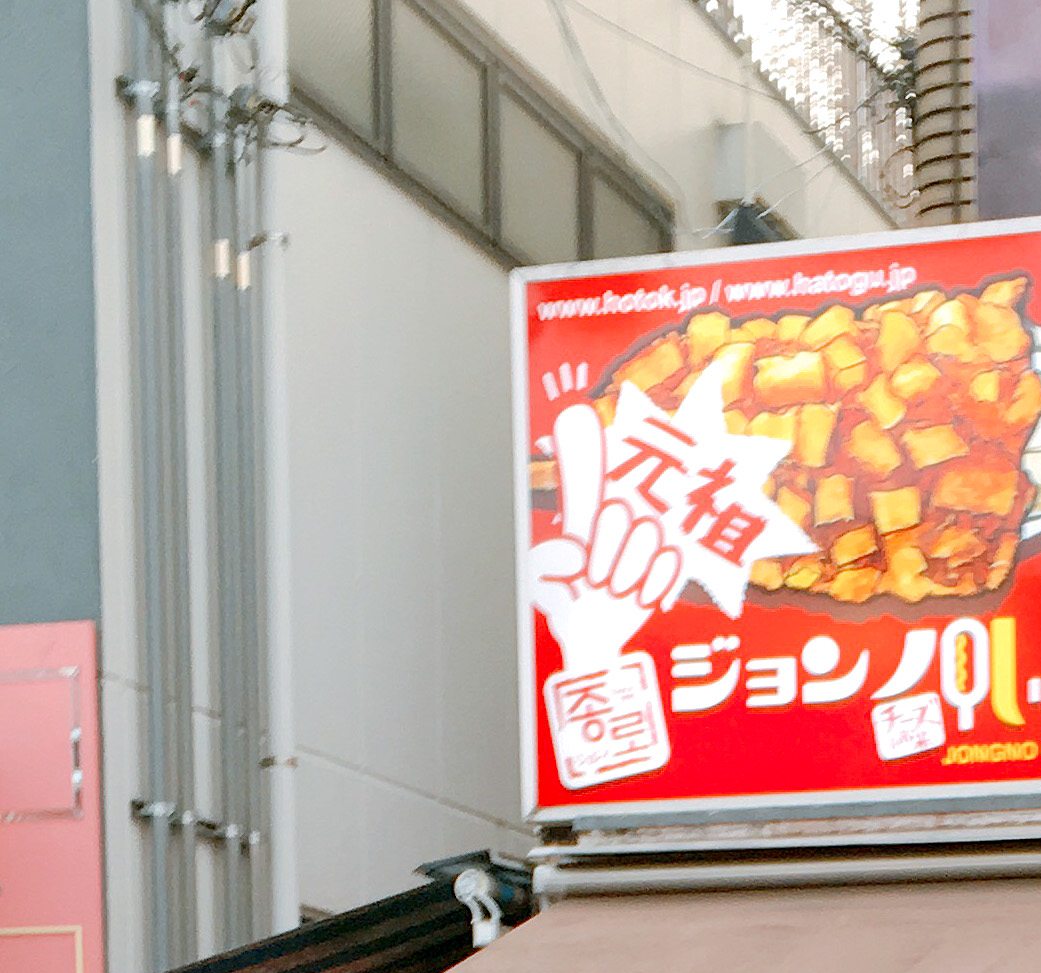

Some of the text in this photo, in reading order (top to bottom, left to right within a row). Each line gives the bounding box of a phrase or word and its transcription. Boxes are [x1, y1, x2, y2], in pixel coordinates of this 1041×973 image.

[536, 283, 707, 321] www.hotok.jp
[724, 262, 917, 303] www.hatogu.jp
[607, 415, 770, 568] 元祖
[879, 696, 943, 733] チーズ
[942, 741, 1038, 765] JONGNO
